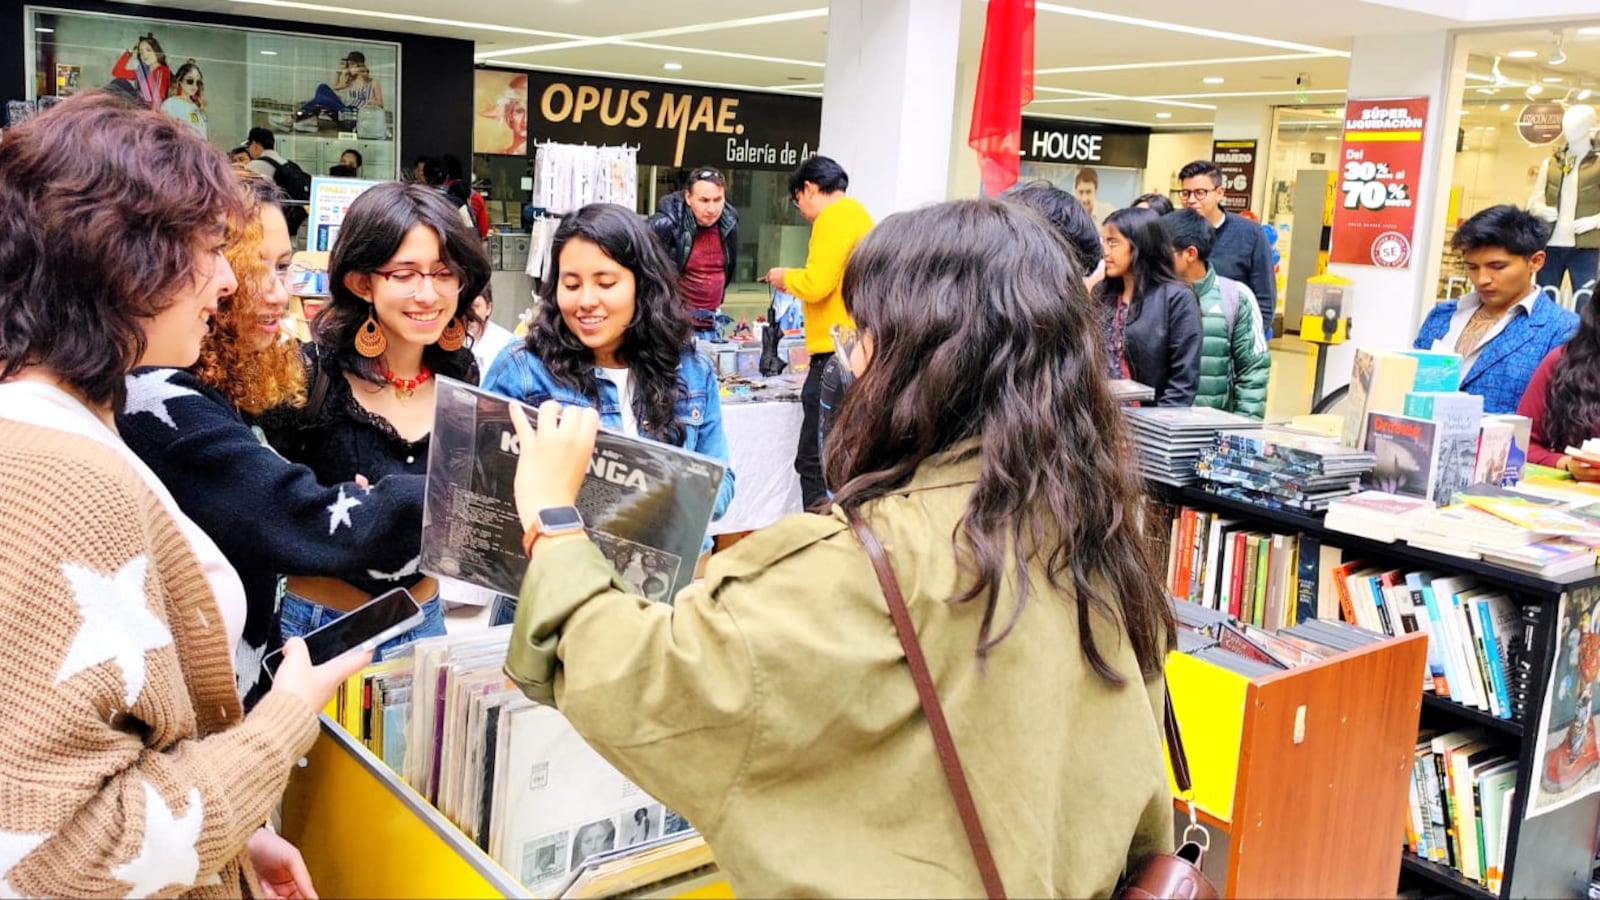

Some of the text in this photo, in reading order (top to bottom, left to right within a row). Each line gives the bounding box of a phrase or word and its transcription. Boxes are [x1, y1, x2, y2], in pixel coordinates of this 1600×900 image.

[1345, 116, 1423, 129] LIQUIDACIÓN
[1361, 105, 1409, 120] SÚPER
[540, 83, 745, 167] OPUS MAE.
[726, 137, 776, 163] Galería
[780, 140, 797, 165] de
[1031, 130, 1103, 161] HOUSE
[1345, 149, 1364, 160] Del
[1214, 153, 1253, 163] MARZO
[1342, 180, 1408, 209] 70%
